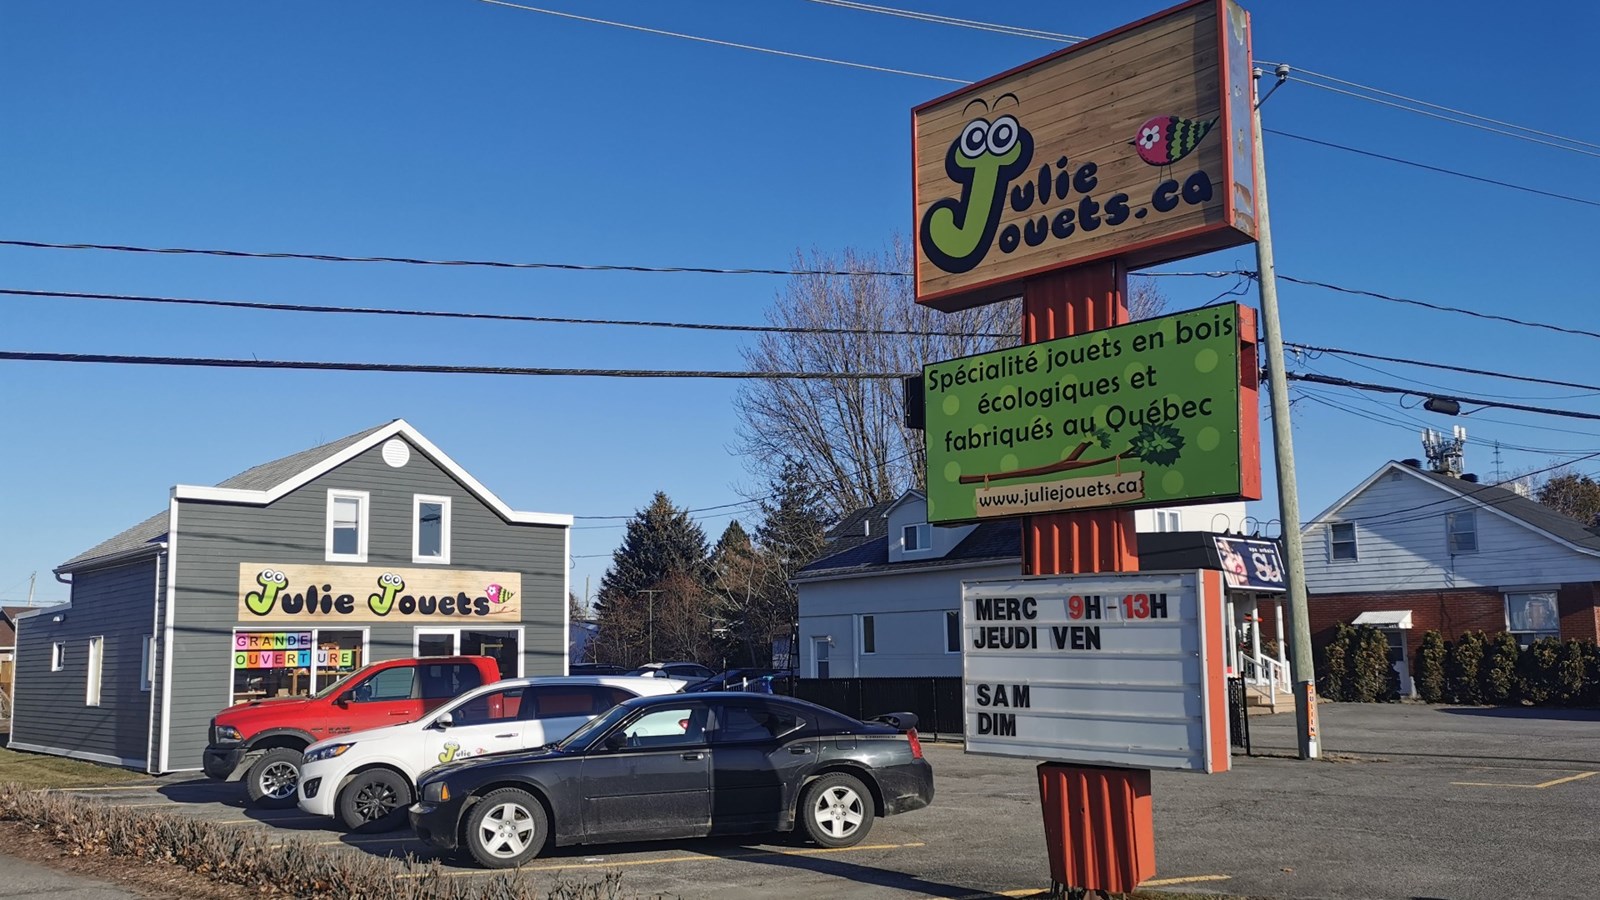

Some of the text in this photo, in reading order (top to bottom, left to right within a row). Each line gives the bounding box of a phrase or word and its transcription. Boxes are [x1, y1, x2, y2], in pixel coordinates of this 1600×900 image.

[929, 314, 1233, 392] Spécialité jouets en bois
[978, 365, 1157, 414] écologiques et
[945, 397, 1212, 452] fabriqués au Québec
[979, 480, 1137, 507] www.juliejouets.ca
[245, 569, 490, 616] Julie Jouets
[976, 597, 1037, 621] MERC
[236, 635, 309, 647] GRANDE
[974, 626, 1101, 650] JEUDI VEN
[235, 653, 350, 665] OUVERTURE
[976, 684, 1031, 708] SAM
[977, 712, 1017, 737] DIM
